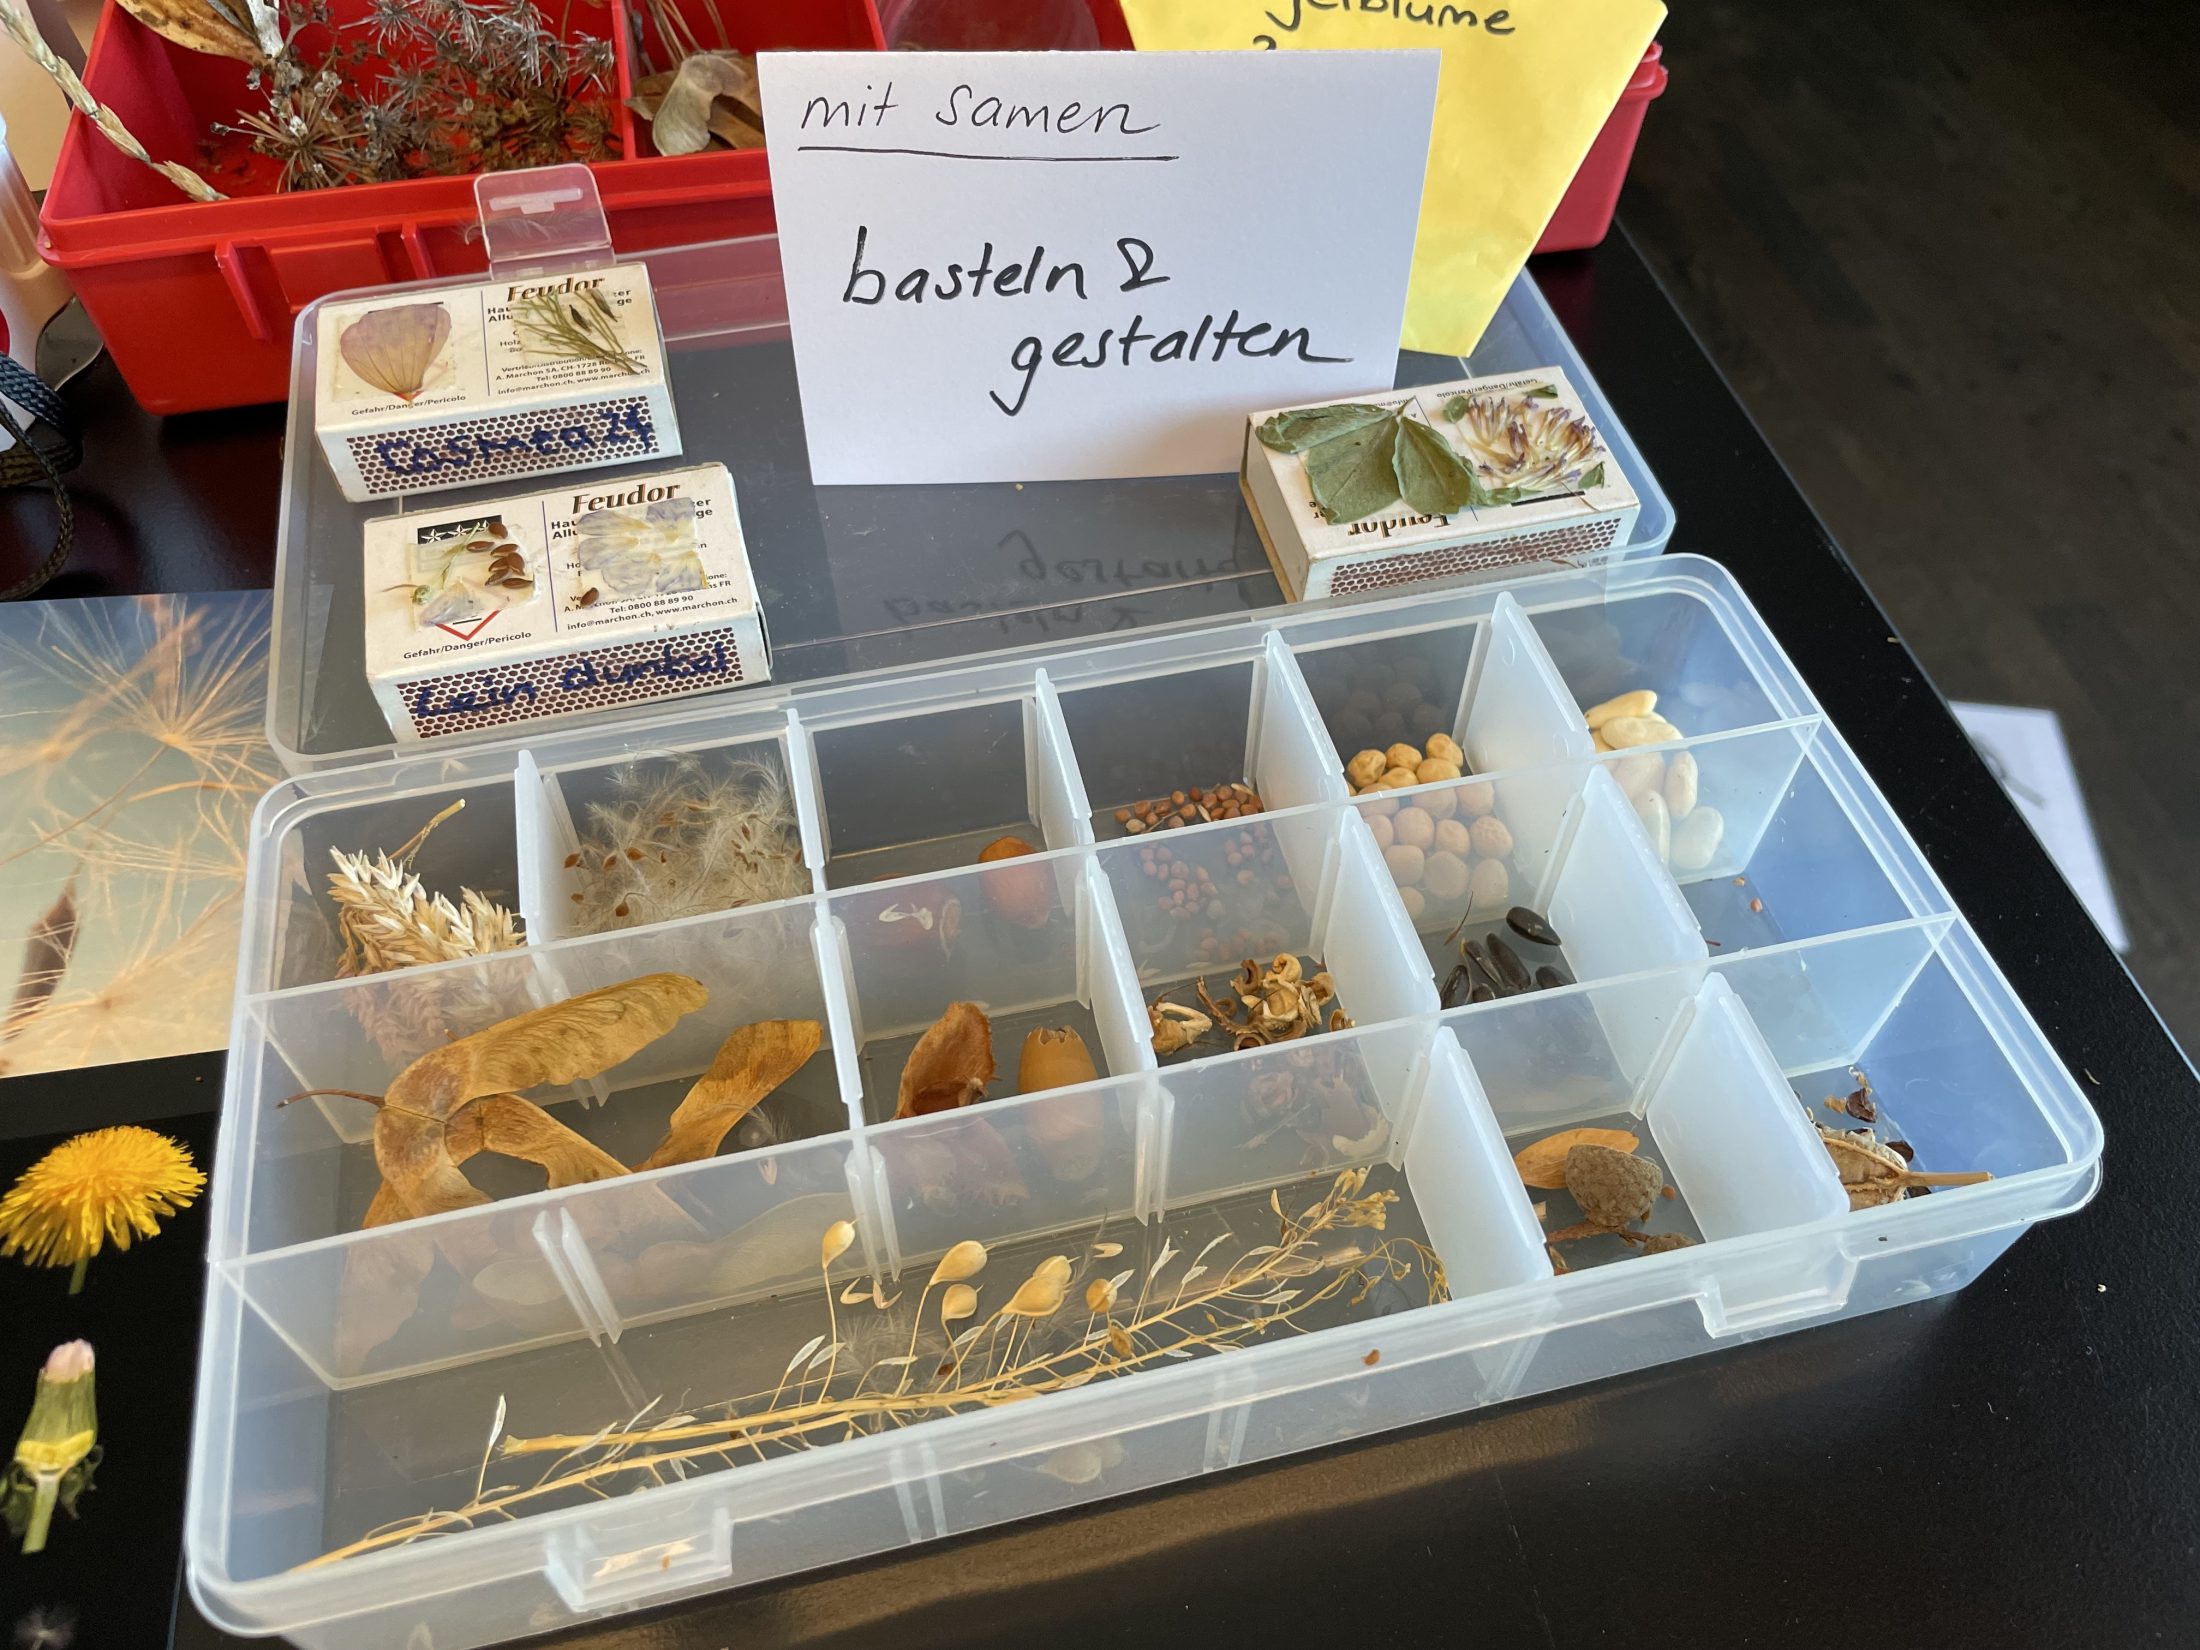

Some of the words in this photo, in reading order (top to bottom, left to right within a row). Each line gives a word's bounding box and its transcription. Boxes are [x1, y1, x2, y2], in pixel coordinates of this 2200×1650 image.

[800, 82, 899, 128] mit
[843, 226, 1088, 305] basteln
[507, 276, 606, 302] Feudor
[506, 369, 544, 379] Marchon
[552, 371, 574, 380] 0800
[989, 309, 1354, 416] gestalten
[572, 483, 680, 514] Feudor
[567, 610, 654, 630] info@marchon.ch,
[655, 597, 738, 615] www.marchon.ch
[609, 606, 627, 614] Tel:
[628, 601, 651, 611] 0800
[403, 631, 532, 659] Gefahr/Danger/Pericolo
